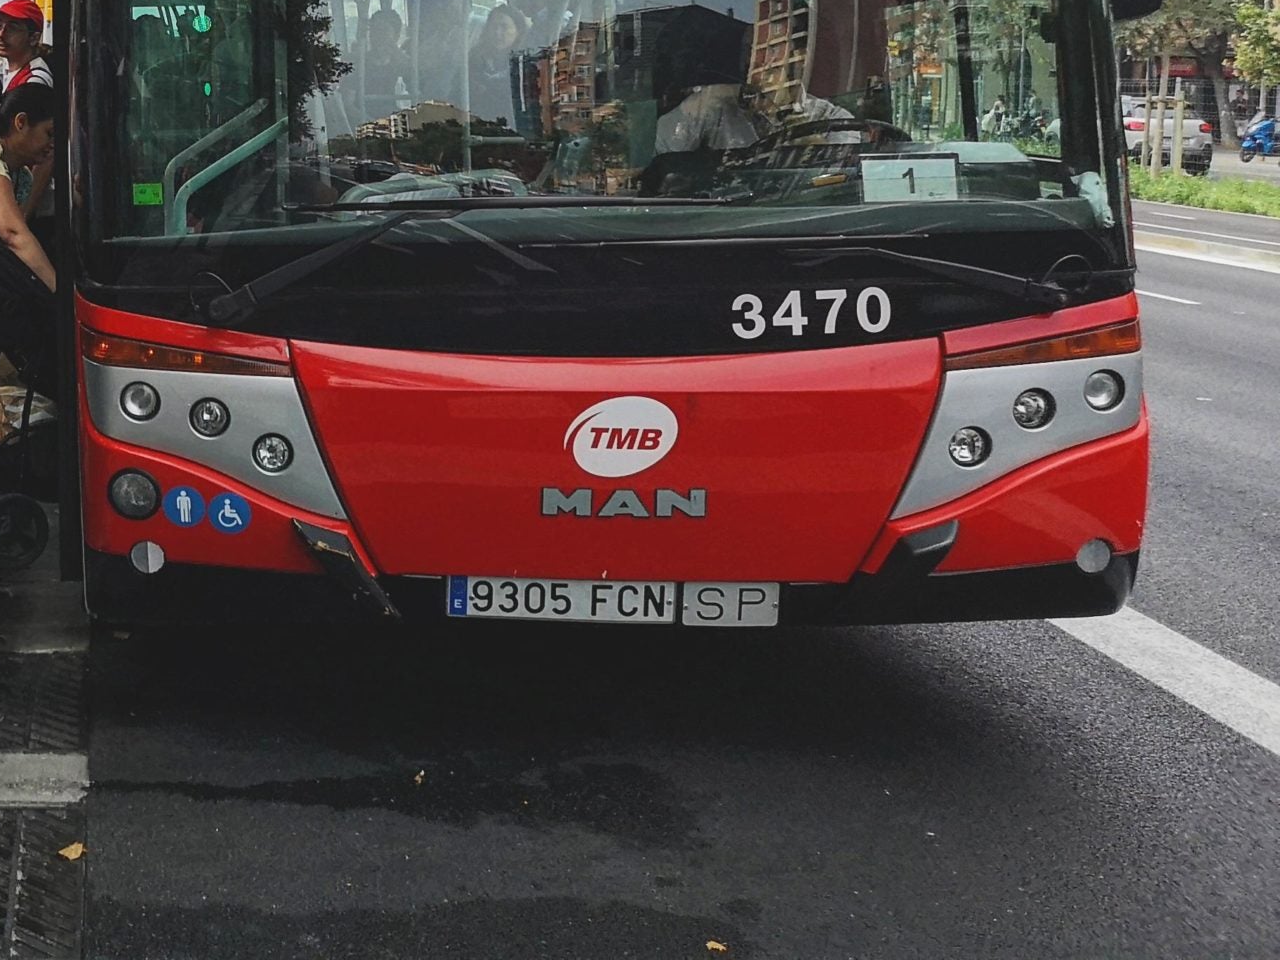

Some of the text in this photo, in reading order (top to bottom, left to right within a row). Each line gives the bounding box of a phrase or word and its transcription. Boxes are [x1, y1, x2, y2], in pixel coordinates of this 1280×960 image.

[902, 167, 916, 194] 1
[731, 286, 891, 340] 3470
[590, 427, 663, 451] TMB
[541, 486, 707, 518] MAN
[454, 580, 666, 618] E 9305 FCN
